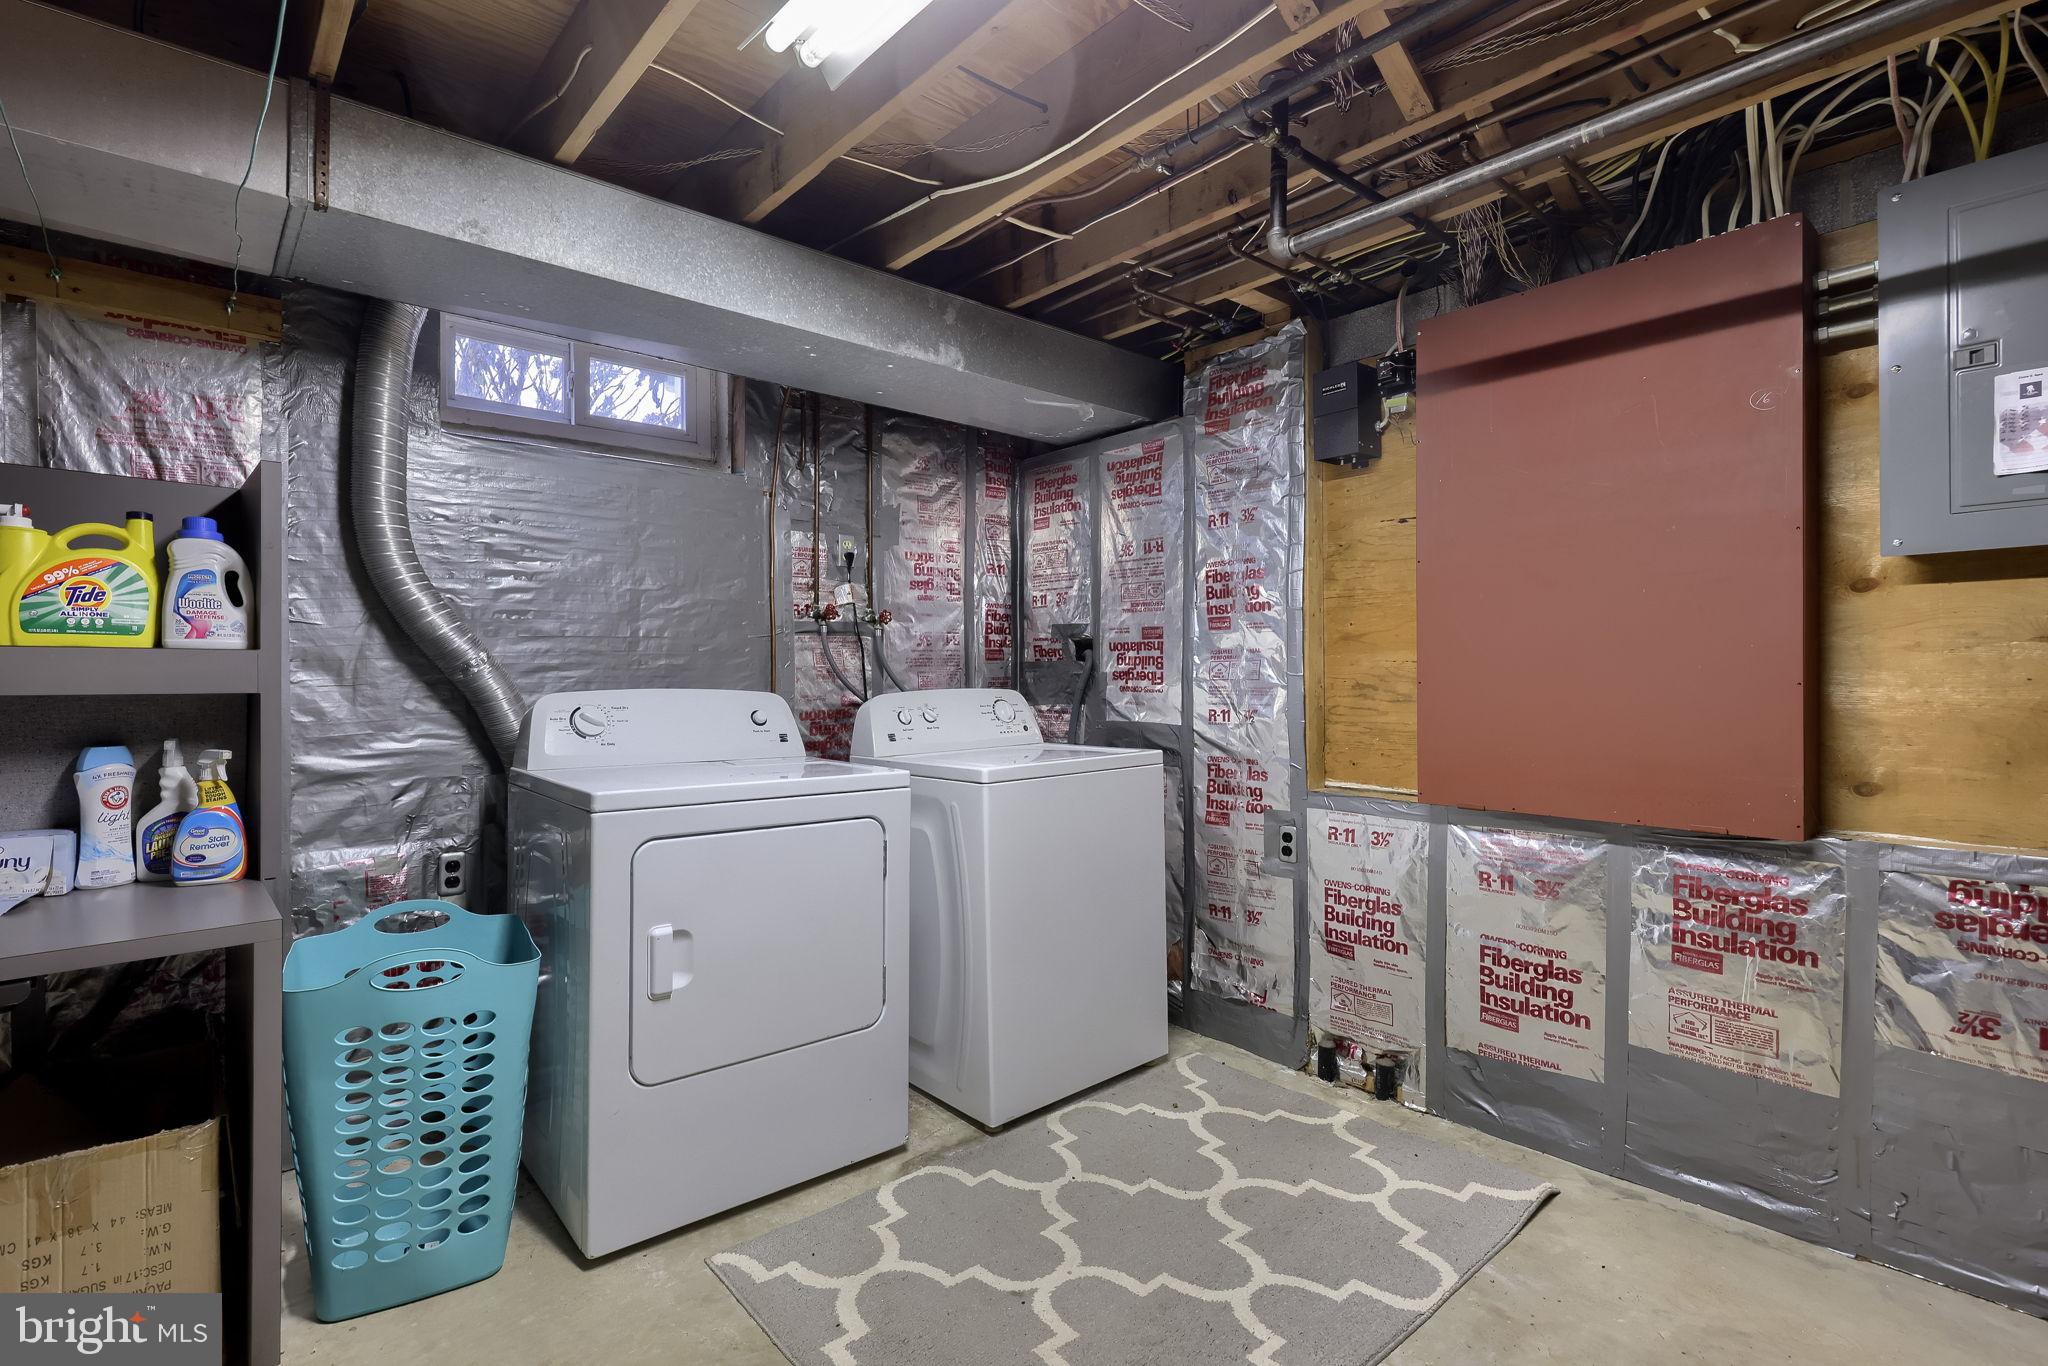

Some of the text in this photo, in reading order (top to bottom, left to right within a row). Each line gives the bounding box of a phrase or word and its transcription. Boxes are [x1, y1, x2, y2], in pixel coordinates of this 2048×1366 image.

[1208, 382, 1264, 407] Building
[1206, 396, 1273, 421] Insulation
[1107, 452, 1163, 472] Insulation
[1035, 473, 1078, 491] Fiberglas
[1115, 466, 1162, 485] Building
[1035, 489, 1073, 505] Building
[1111, 481, 1163, 501] Fiberglas
[1034, 500, 1081, 518] Insulation
[44, 566, 80, 584] 99%
[65, 586, 107, 606] Tide
[178, 597, 222, 609] Woolite
[1109, 640, 1163, 655] Insulation
[1117, 653, 1163, 670] Building
[1112, 669, 1163, 685] Fiberglas
[1208, 709, 1231, 723] R-11
[97, 810, 130, 826] light
[208, 835, 230, 844] Stain
[1328, 826, 1356, 843] R-11
[190, 841, 230, 851] Remover
[1324, 879, 1391, 896] OWENS-CORNING
[1479, 871, 1513, 891] R-11
[1324, 887, 1402, 916] Fiberglas
[1673, 874, 1809, 916] Fiberglas
[1209, 904, 1231, 919] R-11
[1324, 904, 1395, 938] Building
[1673, 898, 1797, 945] Building
[1324, 922, 1408, 955] Insulation
[1672, 922, 1819, 969] Insulation
[1480, 944, 1583, 984] Fiberglas
[1674, 952, 1720, 970] FIBERGLAS
[1331, 982, 1377, 999] PERFORMANCE
[1360, 984, 1392, 996] THERMAL
[1480, 964, 1573, 1009] Building
[1480, 985, 1591, 1030] Insulation
[1668, 987, 1778, 1018] ASSURED THERMAL
[1668, 995, 1751, 1021] PERFORMANCE
[1481, 1012, 1517, 1029] FIBERGLAS
[1478, 1042, 1562, 1071] ASSURED THERMAL
[1668, 1041, 1707, 1055] WARNING:
[136, 1203, 172, 1219] MEAS:
[92, 1222, 99, 1232] X
[110, 1216, 126, 1228] 44
[141, 1222, 172, 1238] G.W.:
[67, 1225, 83, 1239] 38
[27, 1236, 42, 1249] 41
[20, 1255, 52, 1271] KGS
[113, 1260, 172, 1284] DESC:17 in
[20, 1275, 49, 1292] KGS
